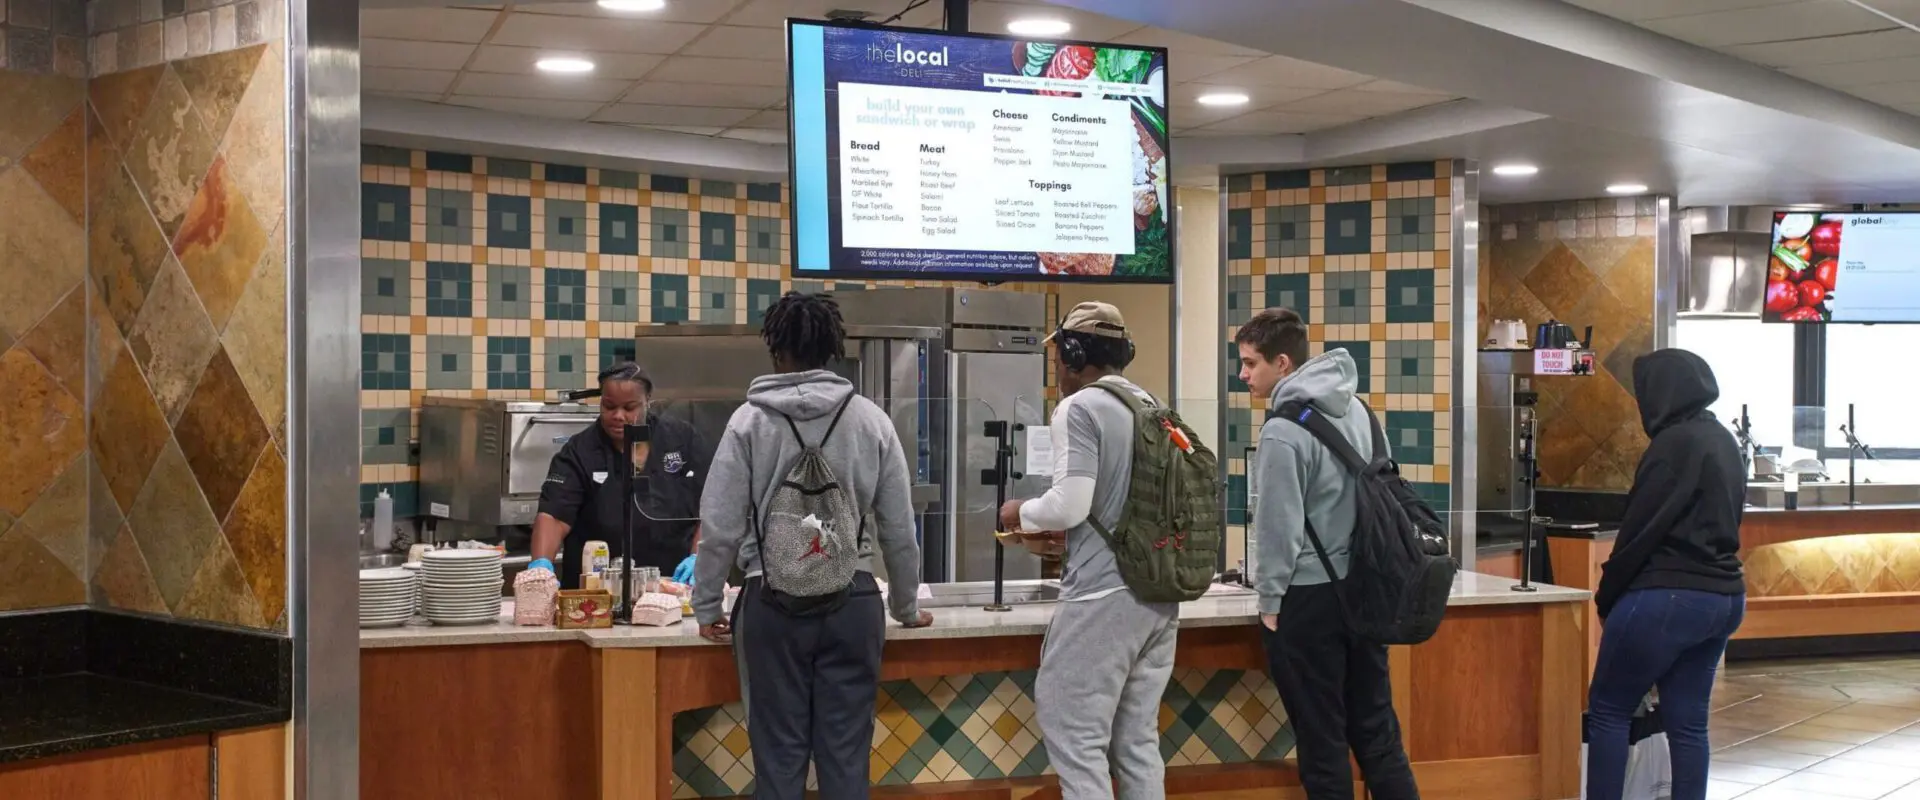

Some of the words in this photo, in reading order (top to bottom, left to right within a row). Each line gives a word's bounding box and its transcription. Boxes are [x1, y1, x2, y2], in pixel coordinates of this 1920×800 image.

[901, 68, 922, 78] DELI
[867, 97, 900, 112] build
[905, 102, 933, 116] your
[938, 105, 965, 116] own
[992, 109, 1028, 120] Cheese
[1051, 113, 1107, 125] Condiments
[856, 112, 920, 126] sandwich
[924, 118, 937, 127] or
[941, 119, 976, 133] wrap
[993, 124, 1023, 132] American
[993, 135, 1011, 143] Swiss
[1053, 138, 1073, 146] Yellow
[1074, 139, 1099, 147] Mustard
[850, 140, 880, 151] Bread
[919, 144, 945, 154] Meat
[993, 146, 1024, 154] Provolone
[1053, 149, 1068, 158] Dijon
[1070, 150, 1095, 158] Mustard
[851, 155, 870, 163] White
[920, 158, 940, 168] Turkey
[994, 157, 1016, 166] Pepper
[920, 170, 940, 179] Honey
[851, 179, 879, 187] Marbled
[881, 180, 893, 189] Rye
[920, 181, 939, 189] Roast
[940, 181, 955, 189] Beef
[1028, 179, 1072, 192] Toppings
[863, 190, 882, 198] White
[920, 192, 943, 200] Salami
[852, 201, 869, 209] Flour
[870, 202, 893, 210] Tortilla
[921, 203, 941, 211] Bacon
[995, 198, 1009, 206] Leaf
[1010, 199, 1034, 207] Lettuce
[1053, 200, 1079, 208] Roasted
[1092, 202, 1117, 211] Peppers
[852, 213, 880, 222] Spinach
[881, 214, 904, 222] Tortilla
[1016, 210, 1040, 218] Tomato
[1054, 211, 1080, 219] Roasted
[922, 215, 937, 223] Tuna
[939, 215, 958, 223] Salad
[922, 227, 935, 236] Egg
[1055, 222, 1078, 230] Banana
[1079, 223, 1104, 232] Peppers
[1084, 234, 1109, 243] Peppers
[860, 250, 877, 258] 2,000
[906, 251, 916, 259] day
[893, 258, 920, 266] Additional
[1541, 351, 1550, 359] DO
[1552, 351, 1563, 359] NOT
